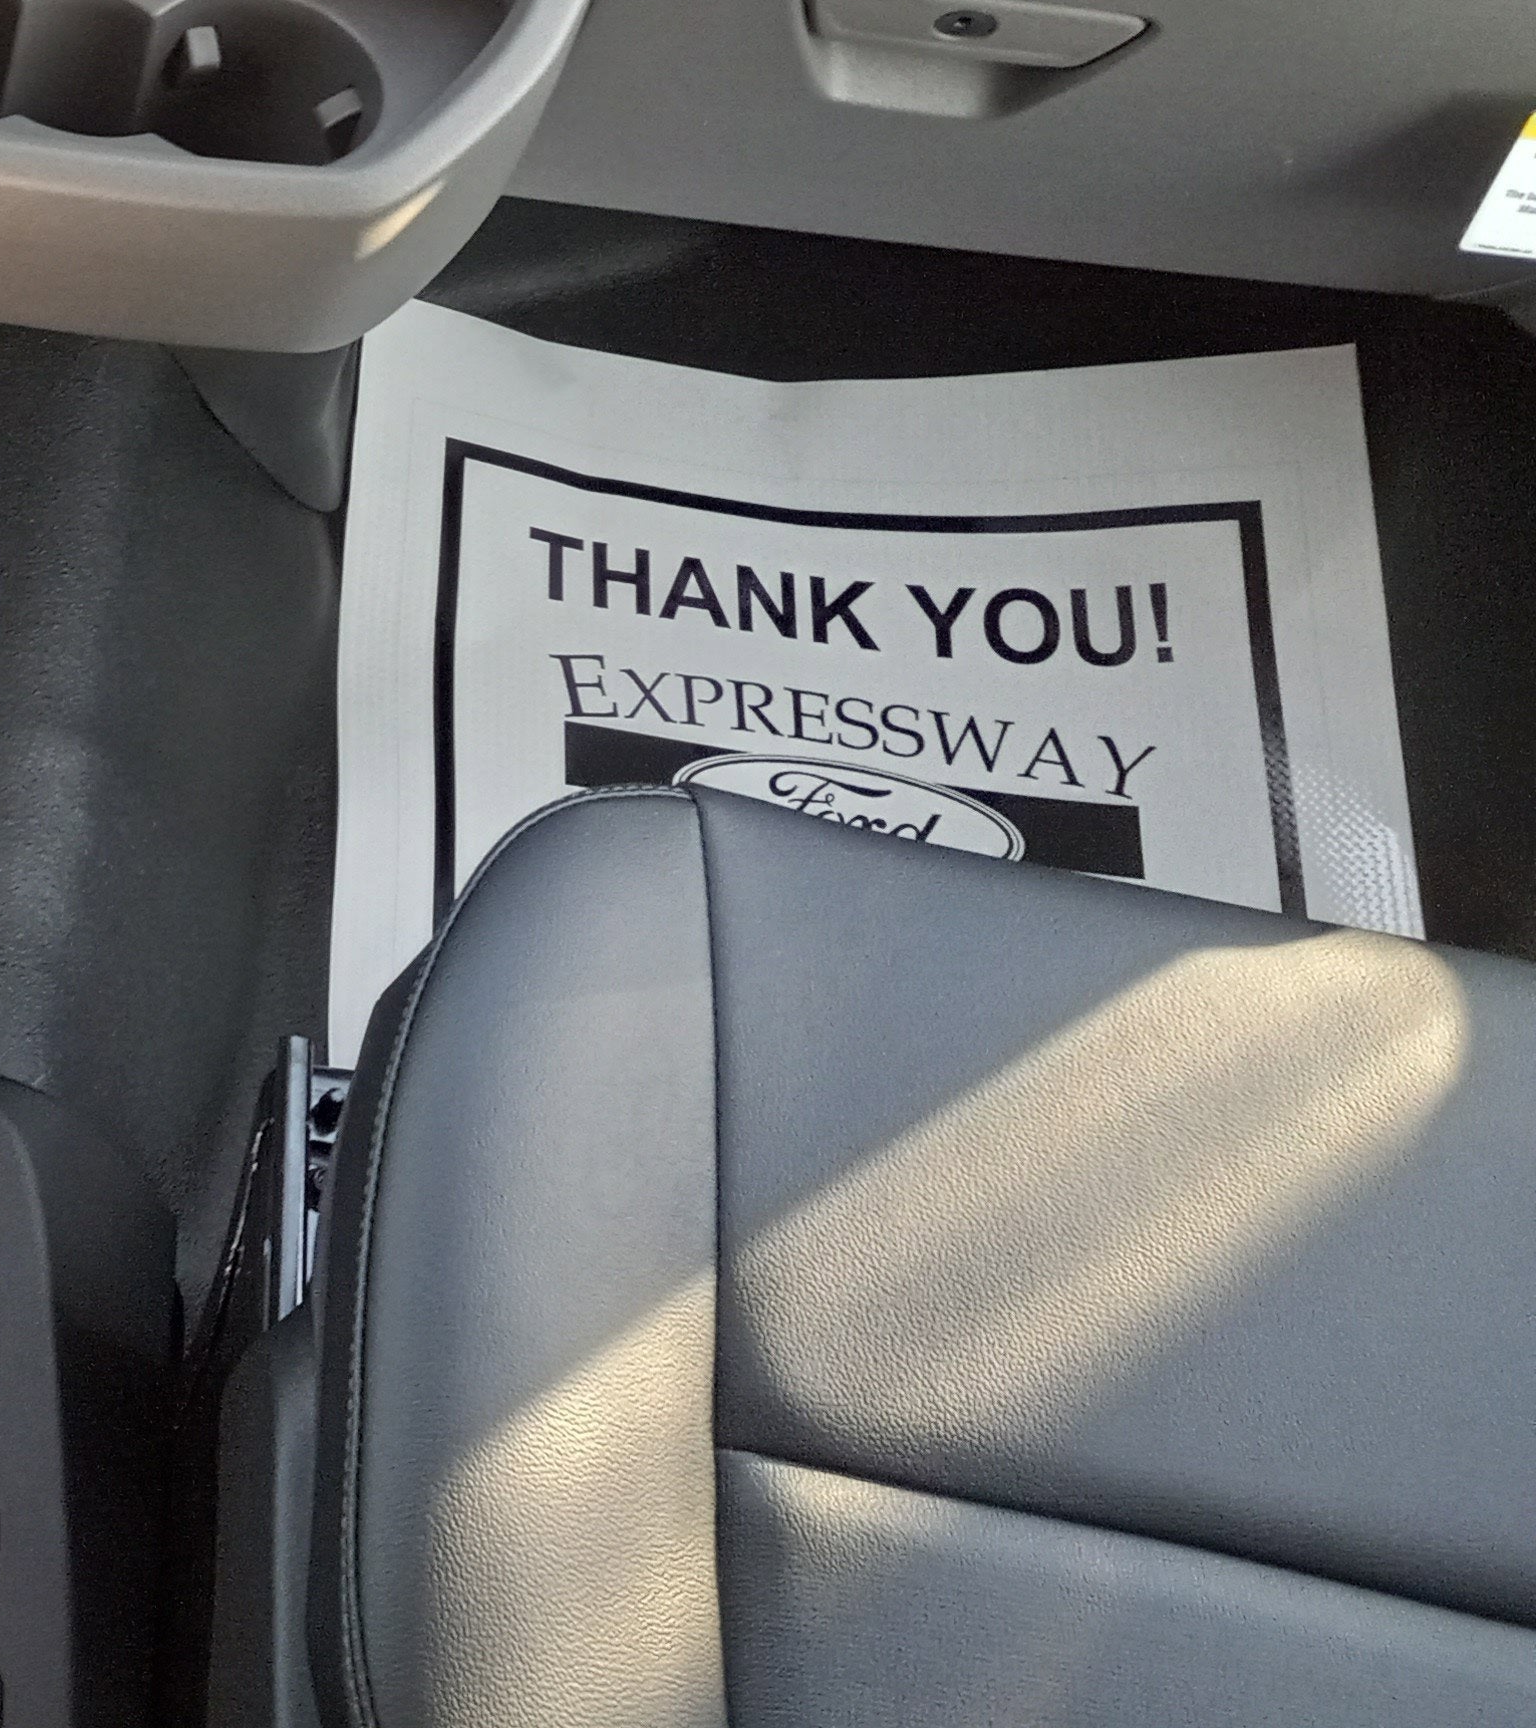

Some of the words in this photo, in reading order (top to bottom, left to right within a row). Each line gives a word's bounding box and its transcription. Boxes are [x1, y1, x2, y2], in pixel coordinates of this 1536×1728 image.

[528, 527, 880, 652] THANK
[906, 581, 1176, 668] YOU!
[550, 653, 1157, 800] EXPRESSWAY
